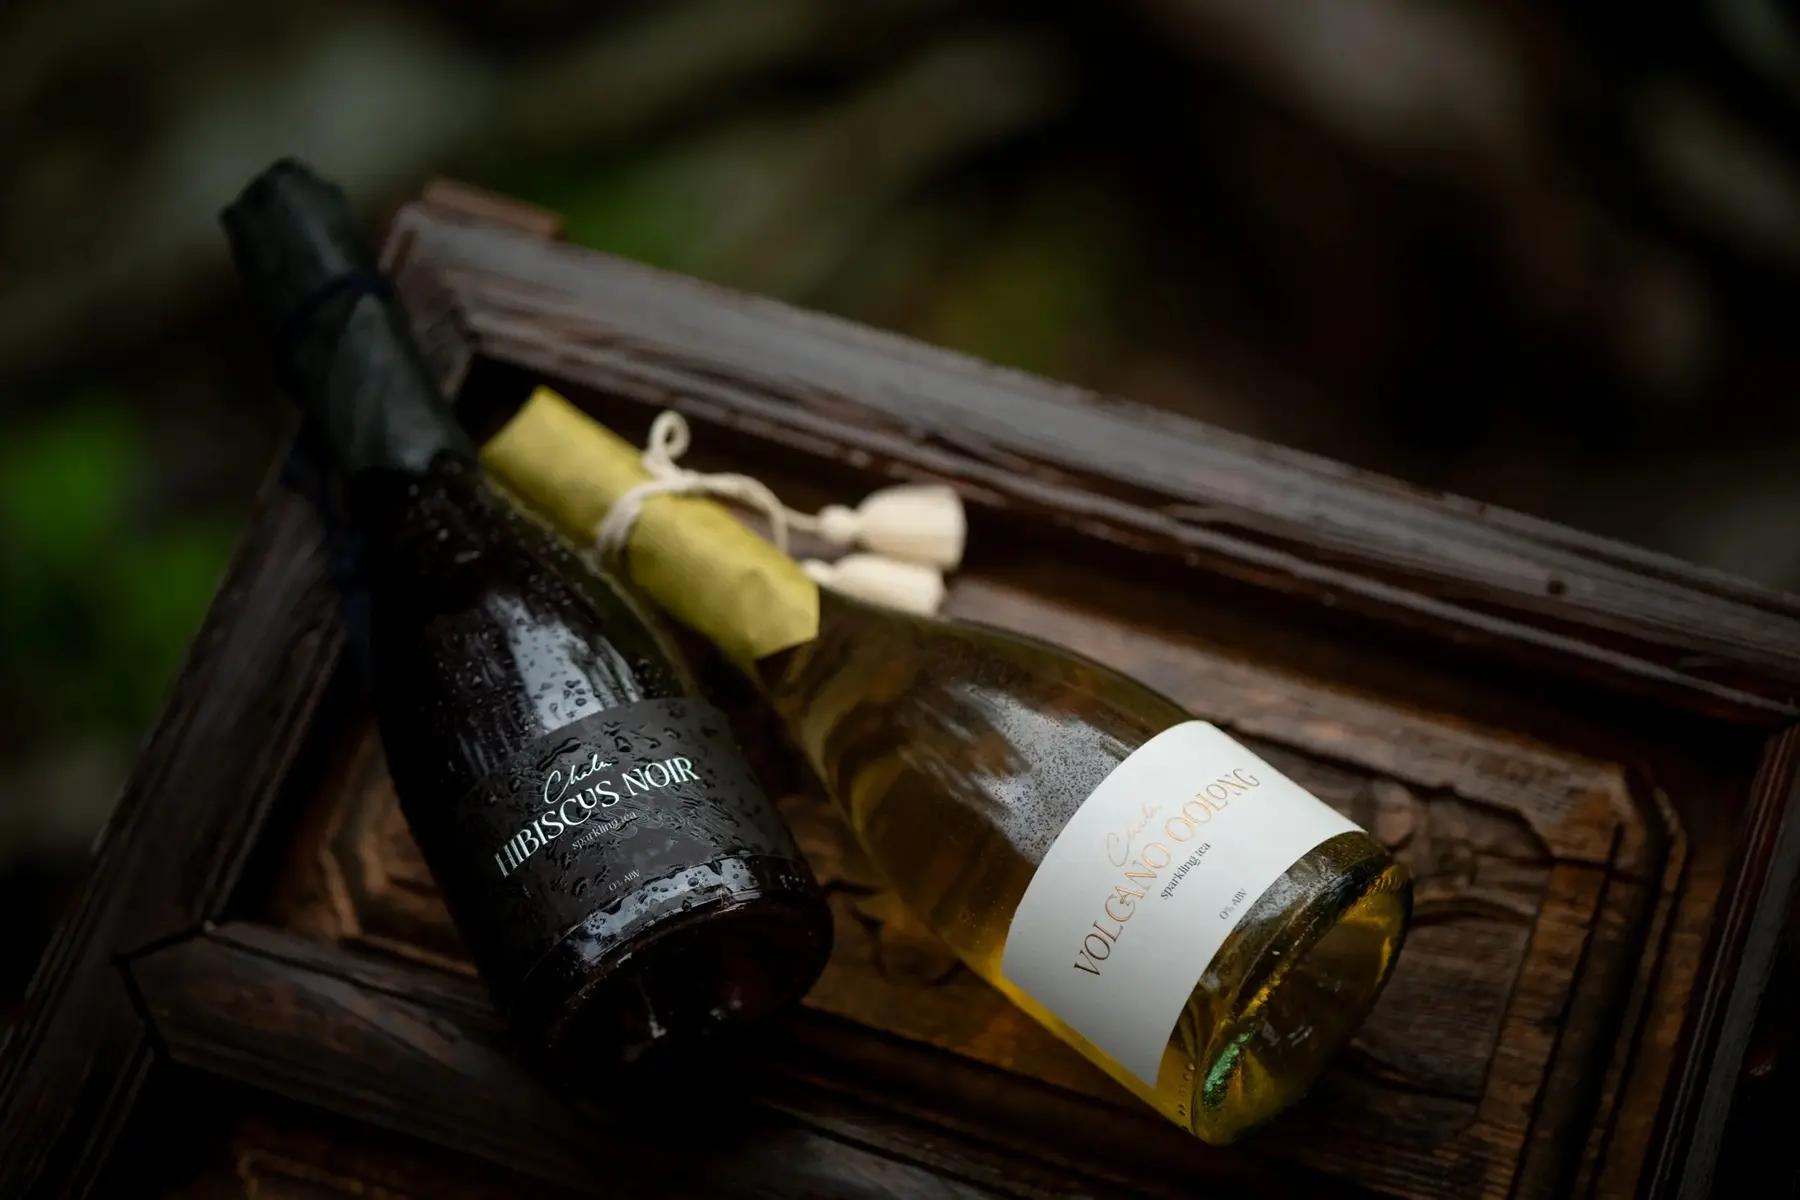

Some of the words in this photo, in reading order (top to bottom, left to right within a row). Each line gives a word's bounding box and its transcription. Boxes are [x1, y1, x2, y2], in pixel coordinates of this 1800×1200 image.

[494, 780, 620, 877] HIBISCUS
[621, 757, 701, 796] NOIR
[571, 818, 620, 850] sparkling
[1073, 842, 1171, 976] VOLCANO
[1165, 767, 1261, 842] OOLONG
[1160, 855, 1201, 900] sparkling
[1195, 842, 1212, 857] tea
[1231, 888, 1248, 905] ABV
